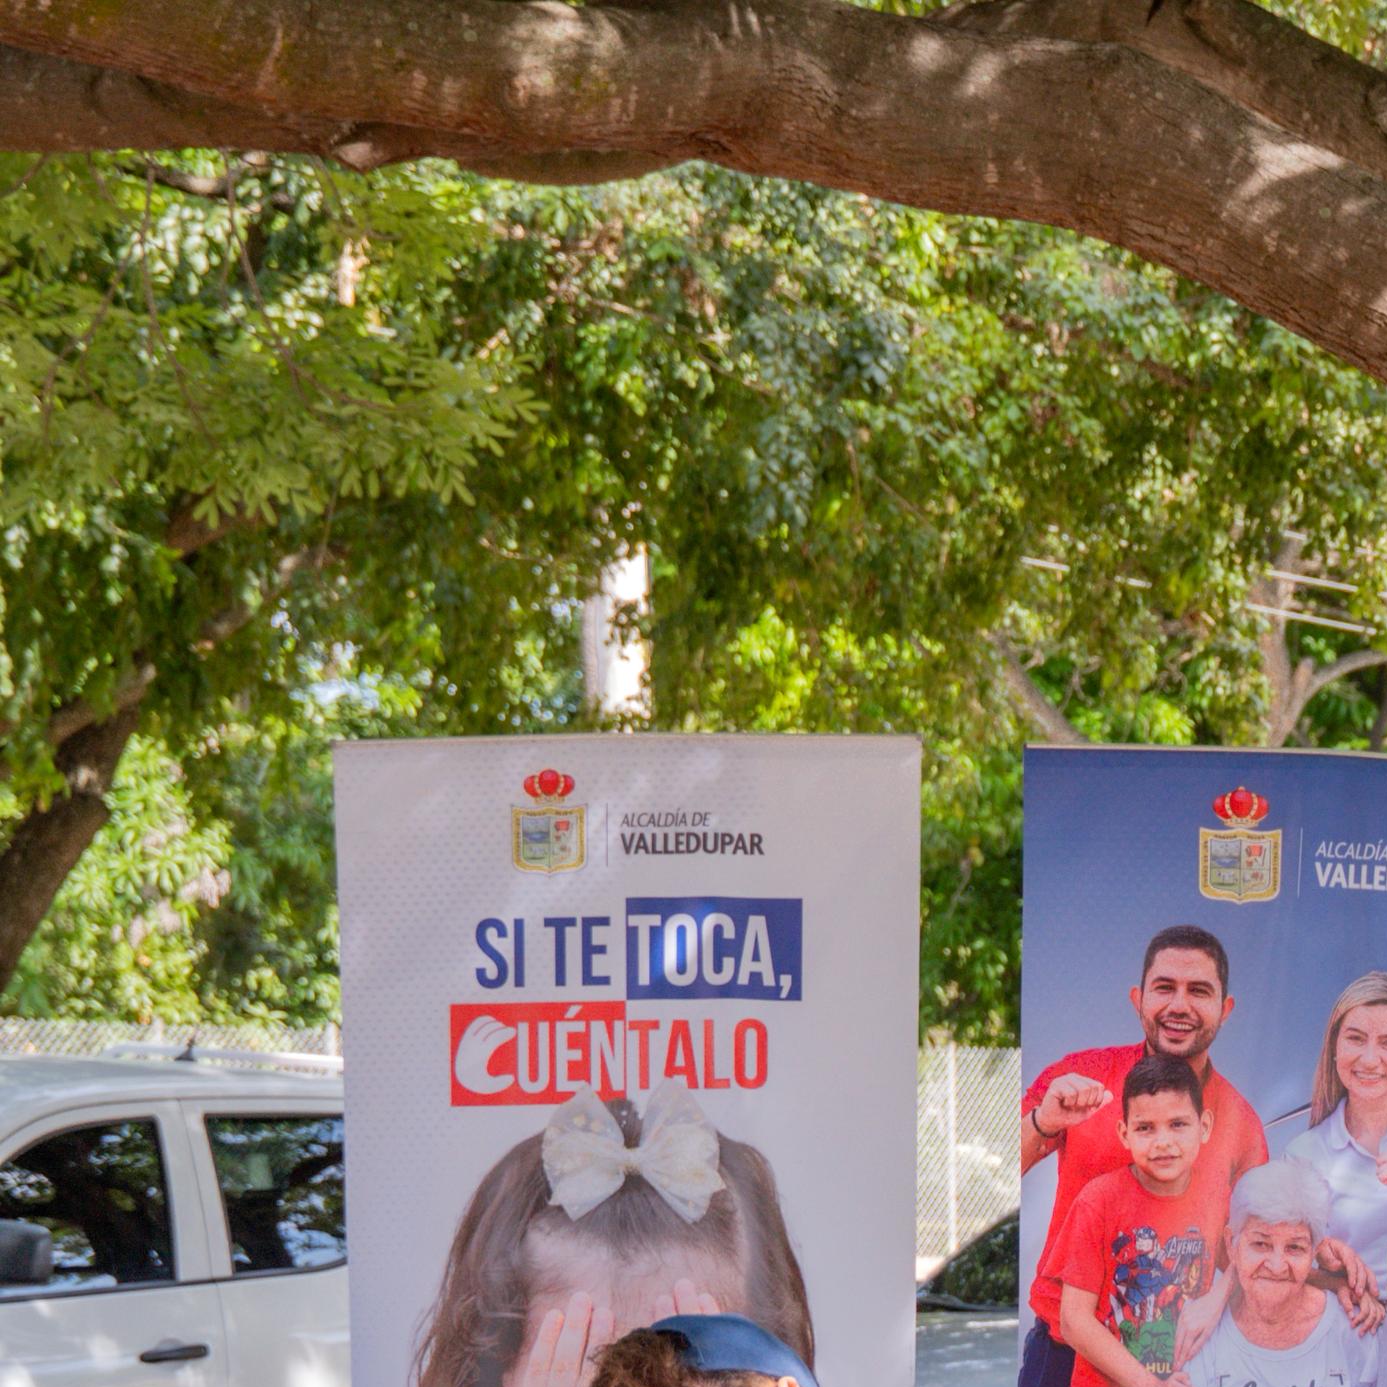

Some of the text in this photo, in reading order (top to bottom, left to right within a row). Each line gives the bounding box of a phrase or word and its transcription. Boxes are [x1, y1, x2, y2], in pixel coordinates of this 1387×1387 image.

[621, 808, 712, 828] ALCALDÍA DE
[621, 832, 765, 856] VALLEDUPAR
[475, 912, 793, 999] SI TE TOCA,
[453, 1004, 768, 1096] CUÉNTALO
